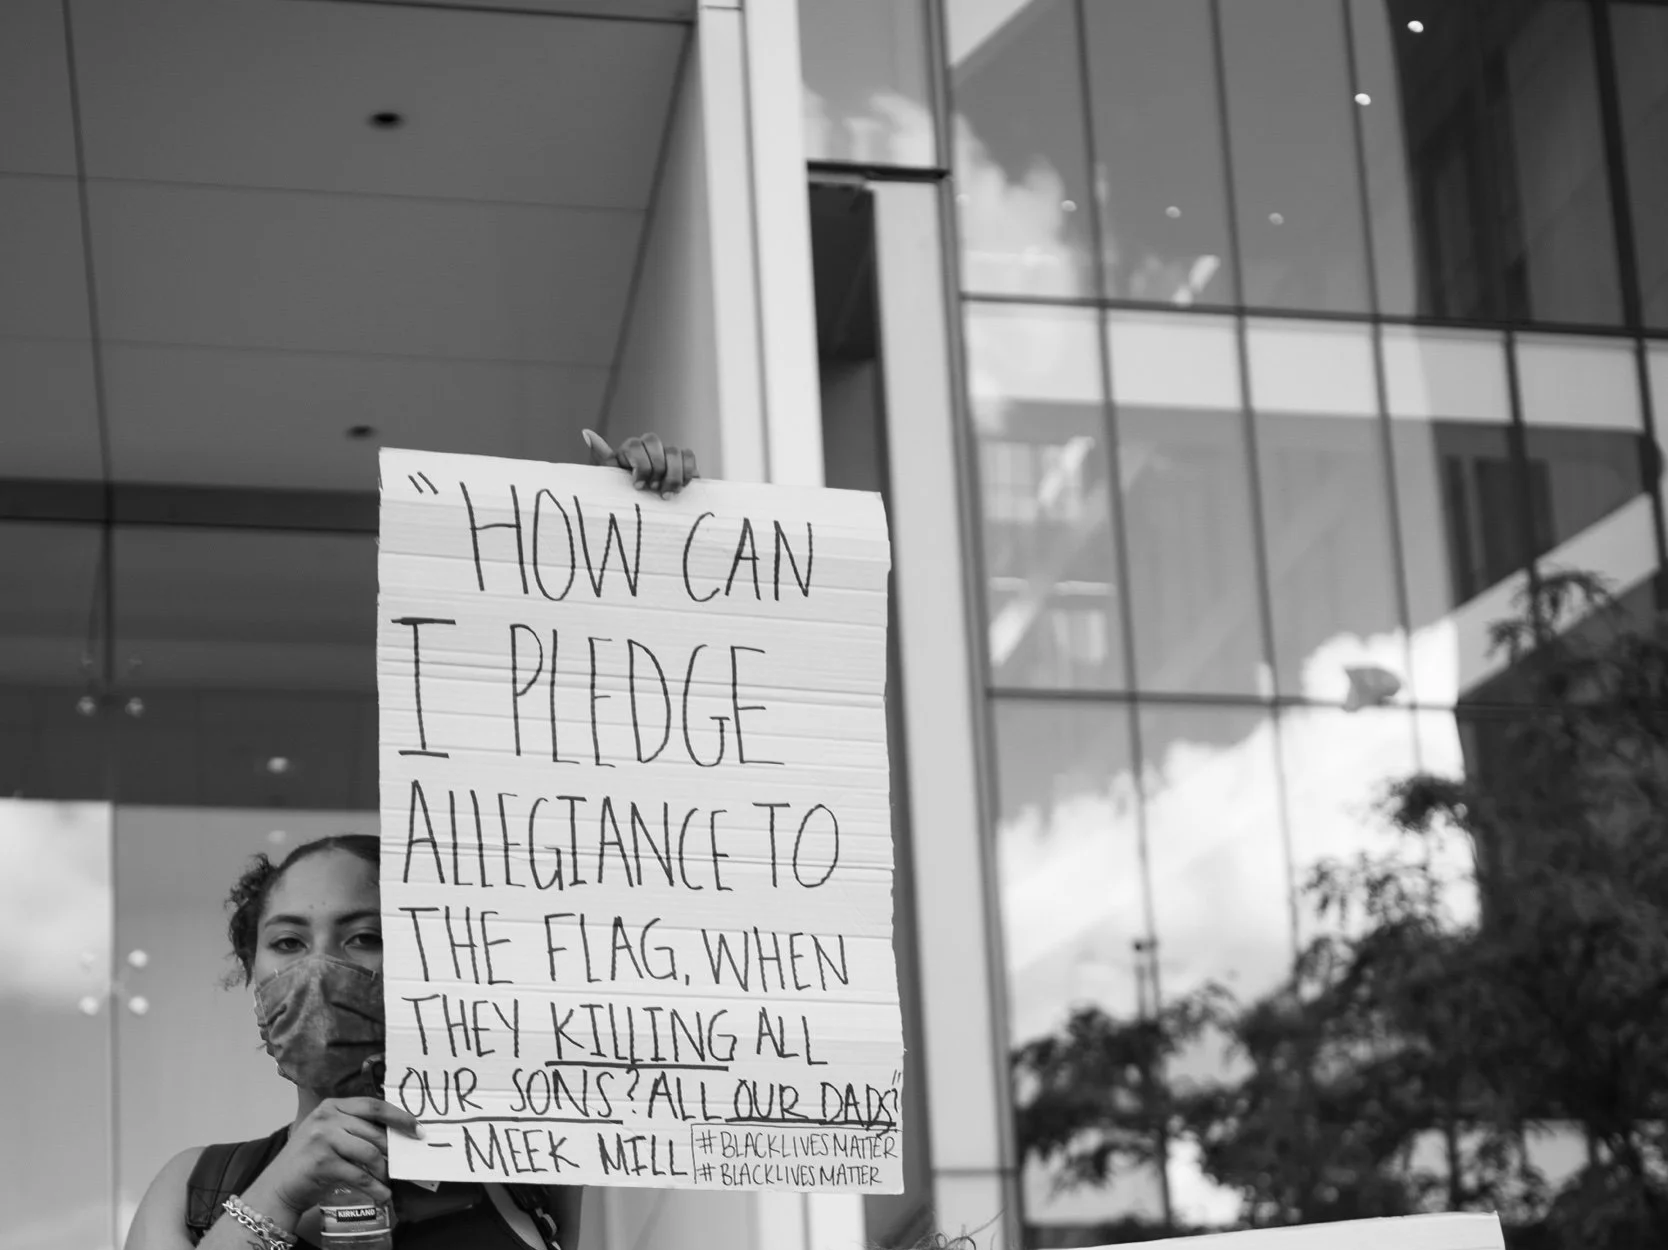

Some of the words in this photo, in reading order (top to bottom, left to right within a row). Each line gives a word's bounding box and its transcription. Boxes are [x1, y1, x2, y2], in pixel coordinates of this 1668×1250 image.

[682, 511, 815, 603] CAN
[391, 617, 456, 759] I
[510, 623, 785, 768] PLEDGE
[402, 779, 733, 891] ALLEGIANCE
[752, 803, 840, 888] TO
[398, 905, 514, 986] THE
[544, 912, 691, 987] FLAG,
[701, 926, 850, 993] WHEN
[401, 994, 520, 1059] THEY
[550, 1001, 737, 1064] KILLING
[756, 1006, 829, 1066] ALL
[399, 1067, 483, 1117] OUR
[510, 1067, 642, 1119] SONS?
[647, 1070, 723, 1122] ALL
[733, 1078, 809, 1121] OUR
[598, 1132, 689, 1177] MILL
[338, 1208, 375, 1218] KIRKLAND
